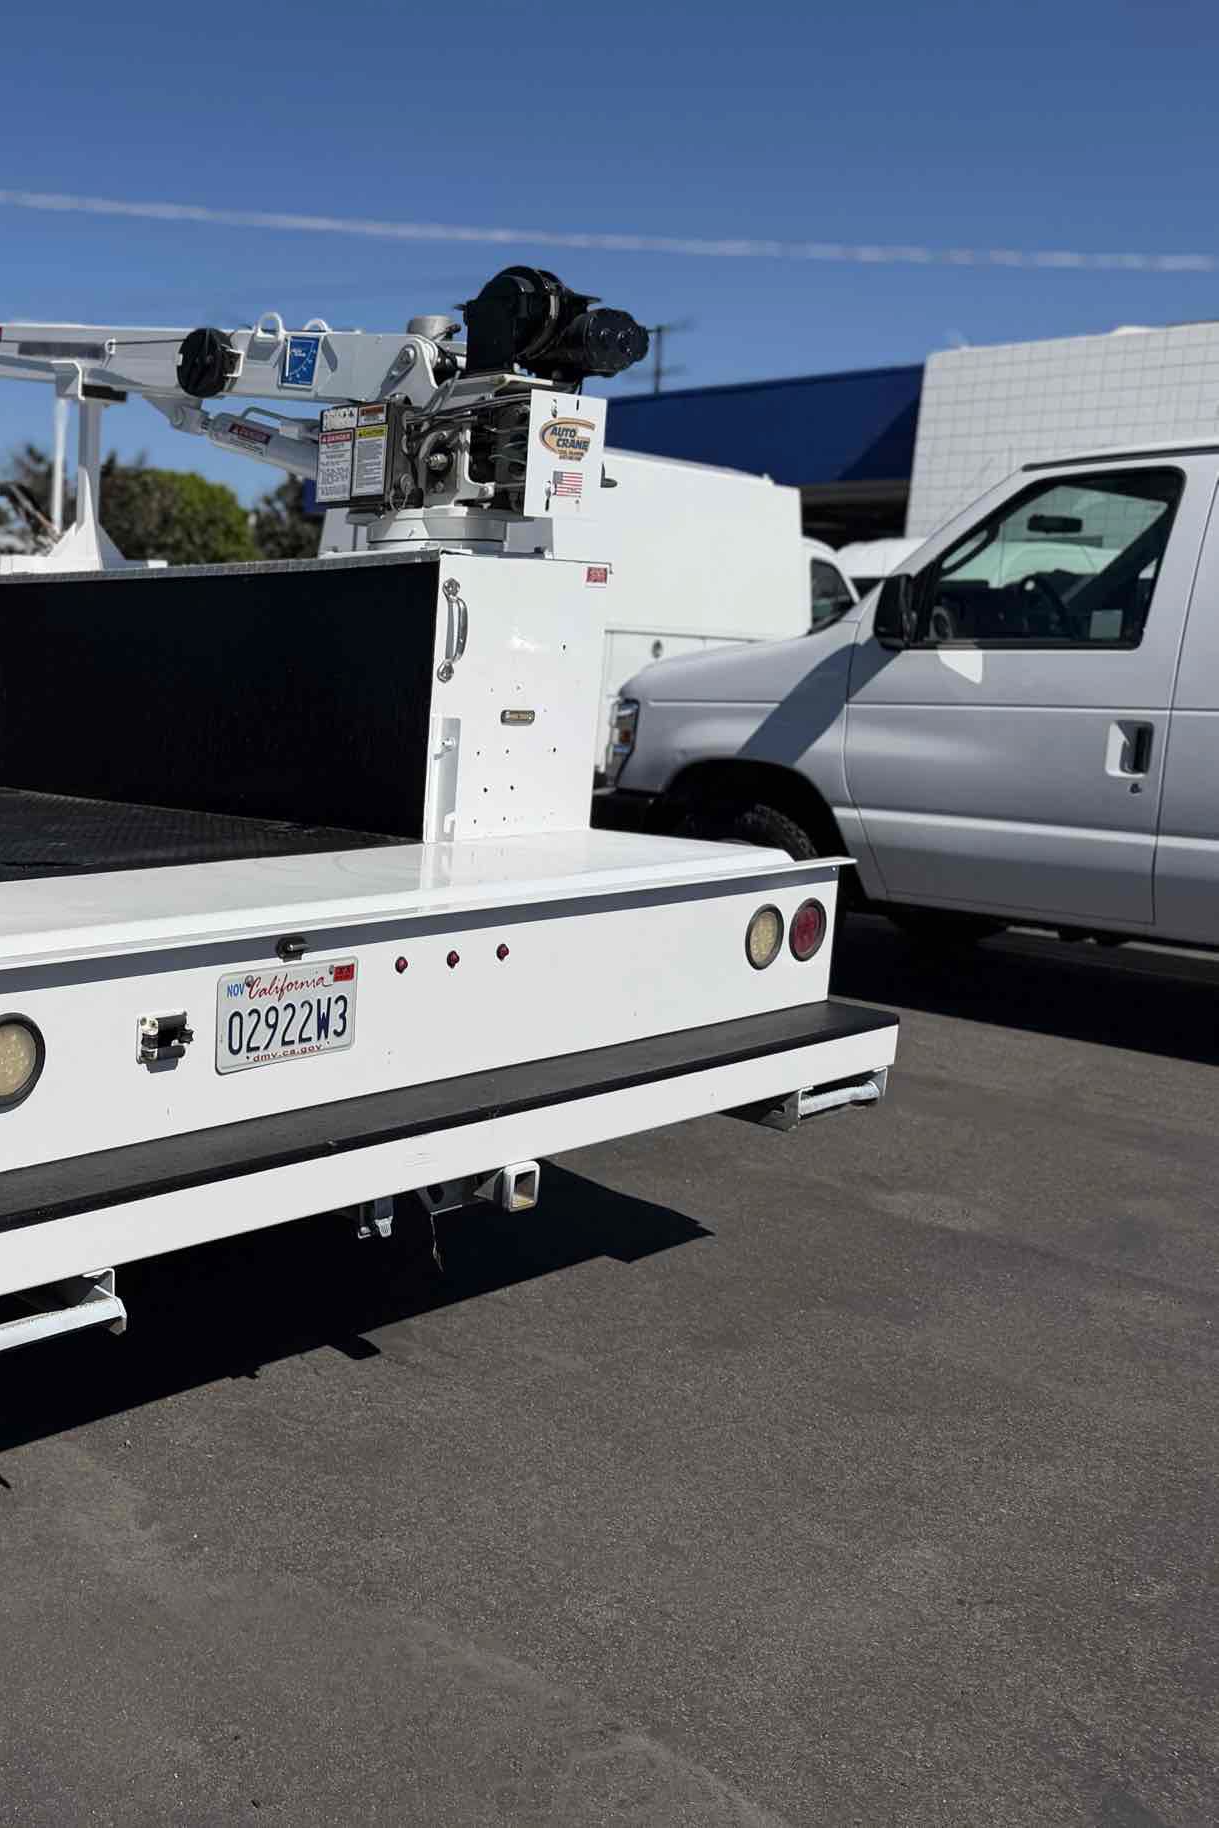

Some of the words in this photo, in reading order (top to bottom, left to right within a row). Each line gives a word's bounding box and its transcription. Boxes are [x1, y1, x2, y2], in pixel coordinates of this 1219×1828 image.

[550, 426, 576, 438] AUTO
[557, 438, 590, 449] CRANE
[226, 983, 245, 998] NOV
[248, 973, 331, 1002] California
[228, 994, 348, 1056] 02922W3
[253, 1043, 323, 1063] dmv.ca.gov
